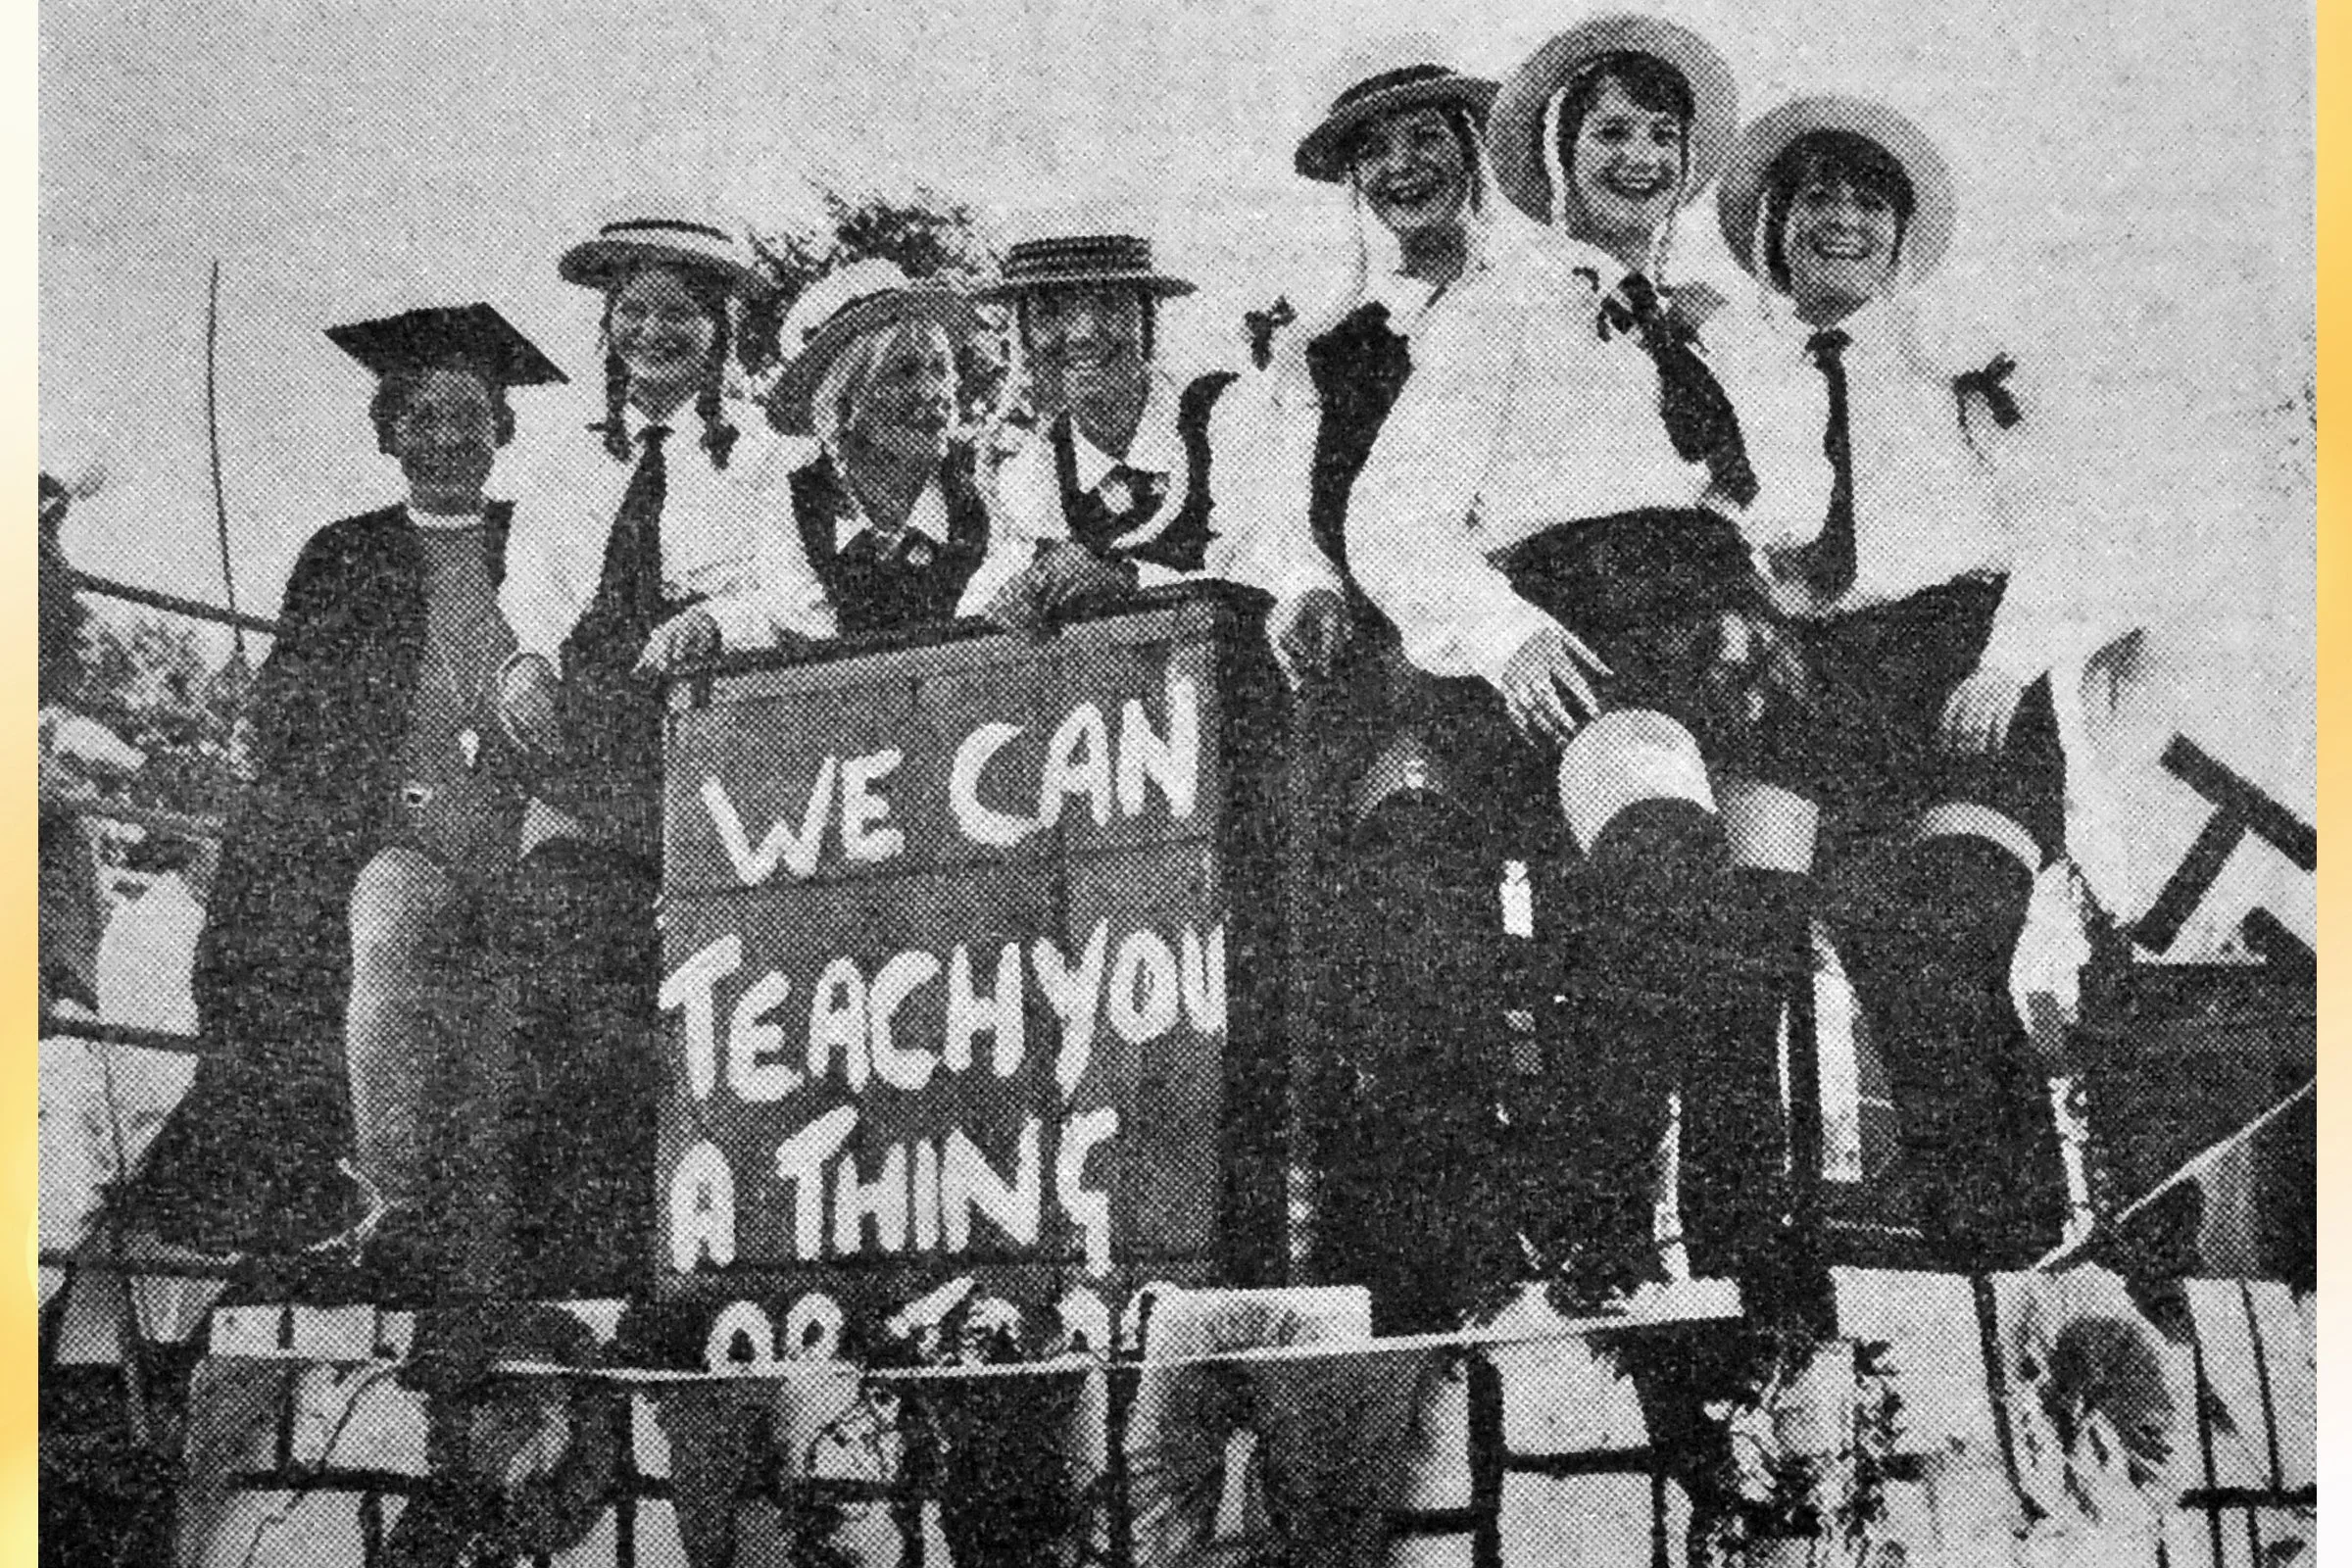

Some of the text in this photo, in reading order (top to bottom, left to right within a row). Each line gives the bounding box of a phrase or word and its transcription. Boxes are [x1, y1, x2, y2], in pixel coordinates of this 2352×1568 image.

[700, 668, 1200, 884] WE CAN
[658, 916, 1228, 1103] TEACH YOU
[669, 1103, 1119, 1279] A THING
